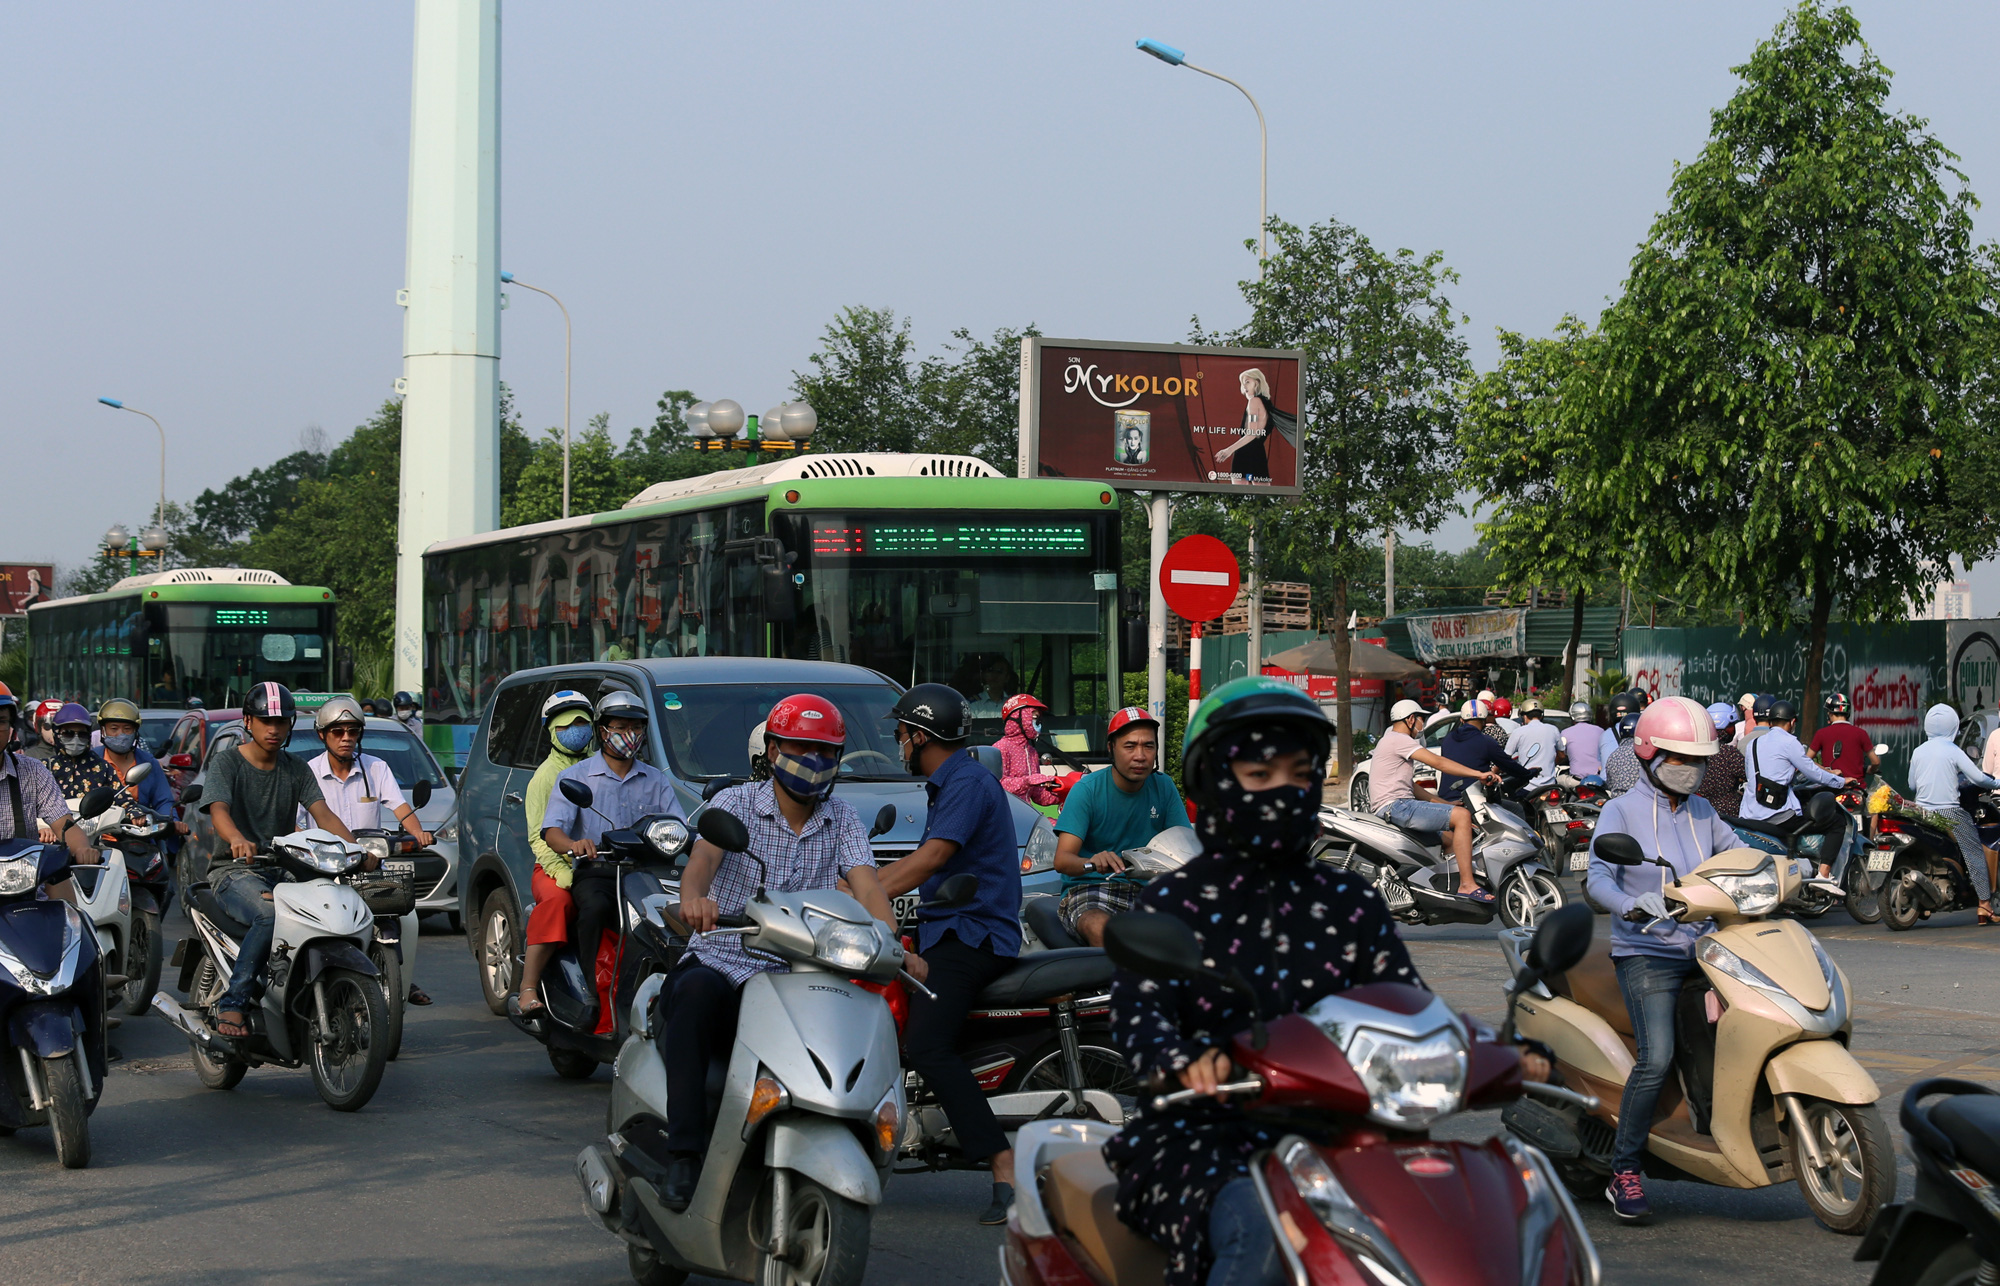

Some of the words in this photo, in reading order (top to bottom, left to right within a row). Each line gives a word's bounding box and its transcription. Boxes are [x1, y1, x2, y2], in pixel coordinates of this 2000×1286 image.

[1193, 425, 1205, 434] MY
[1208, 426, 1226, 435] LIFE
[1230, 427, 1267, 437] MYKOLOR
